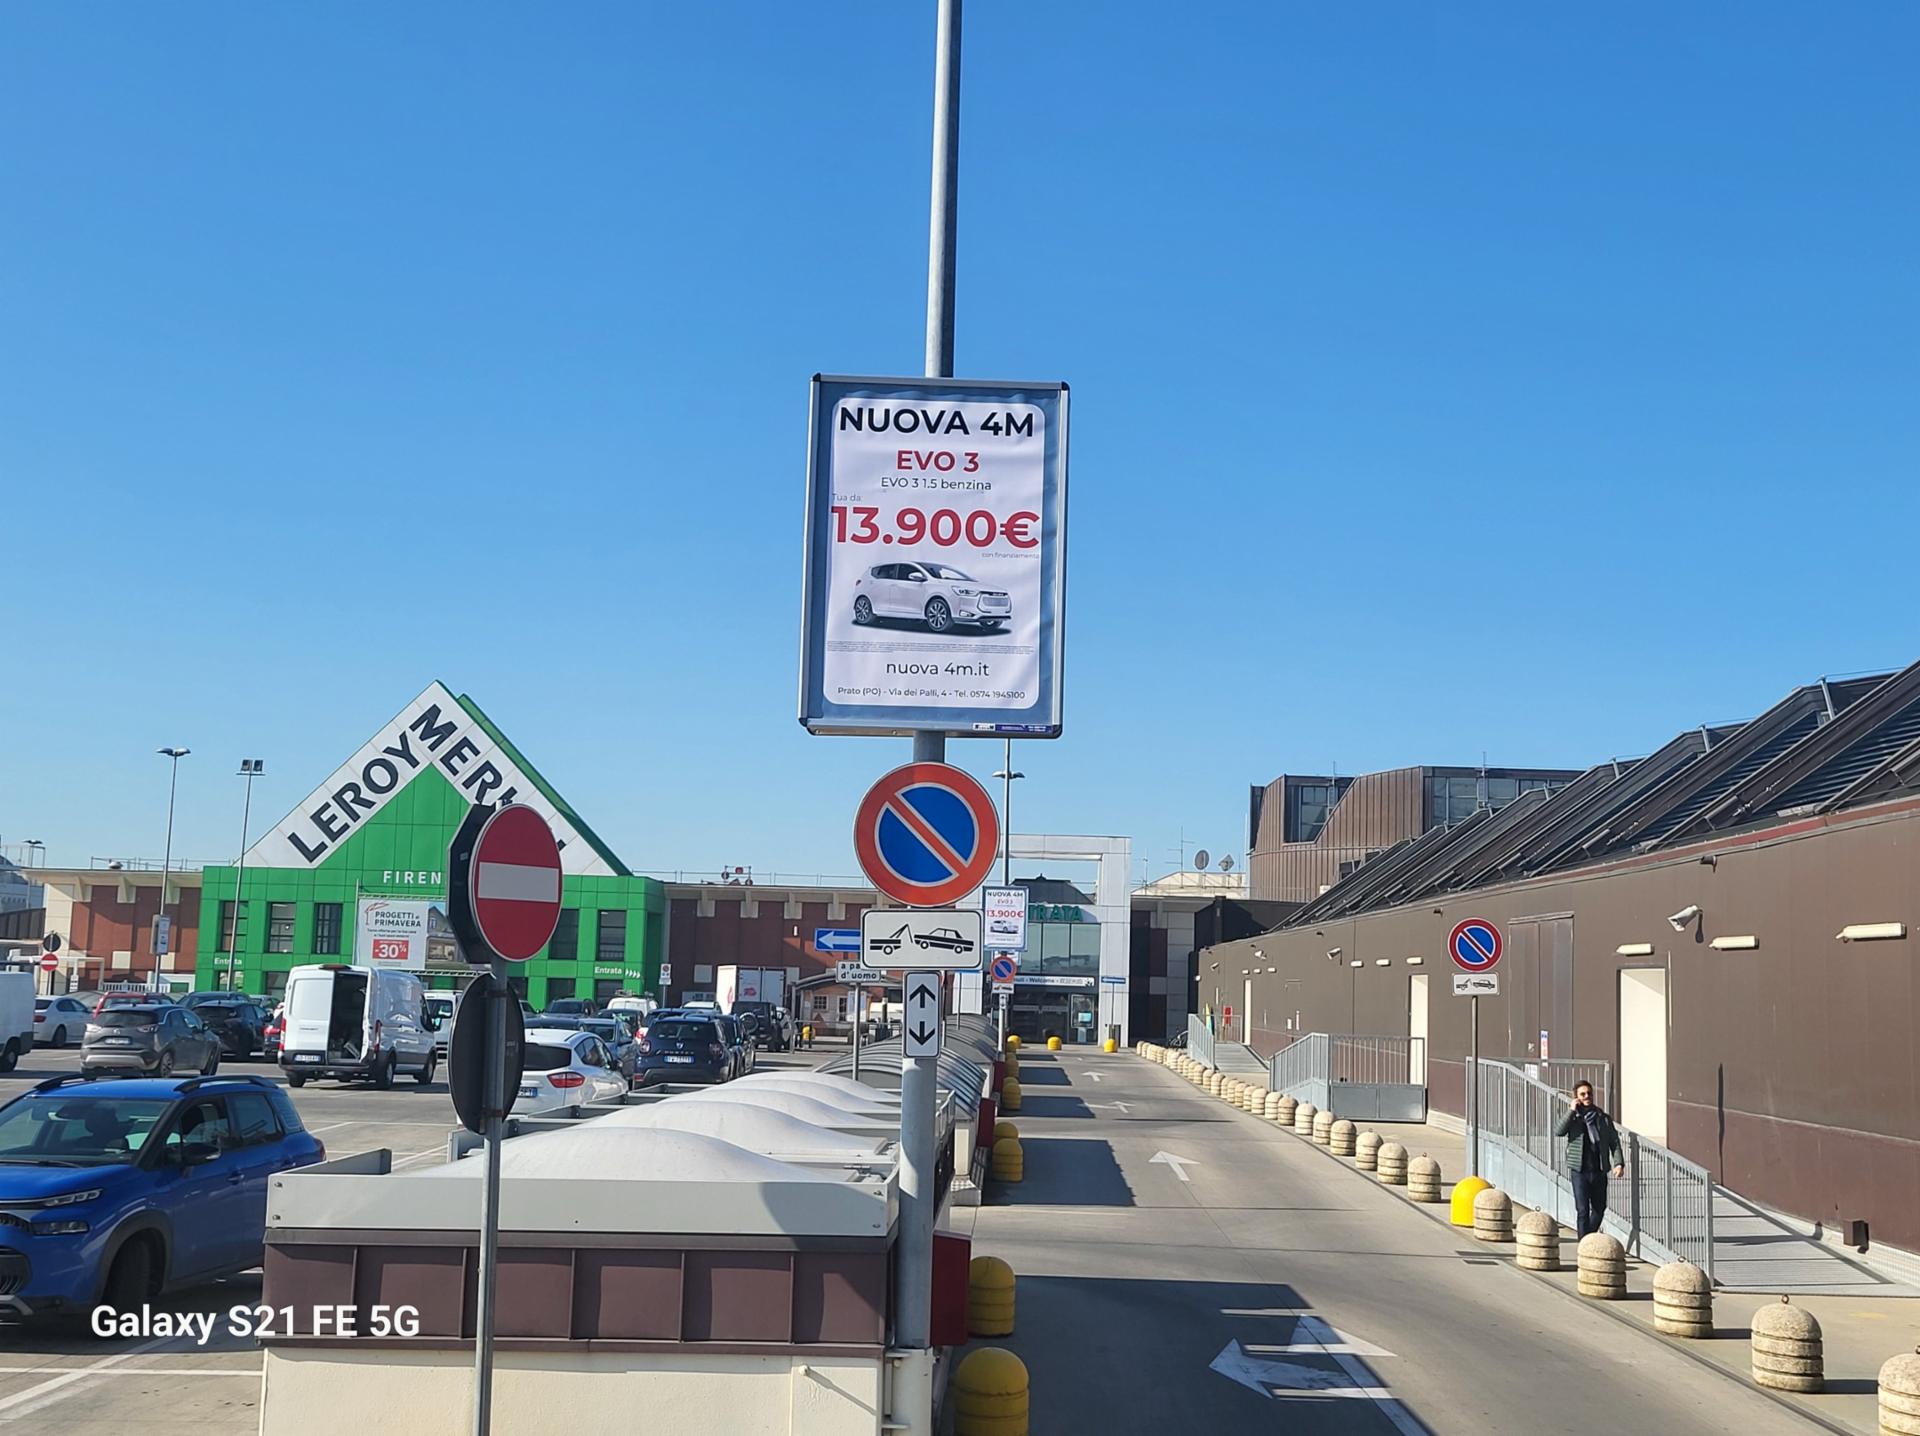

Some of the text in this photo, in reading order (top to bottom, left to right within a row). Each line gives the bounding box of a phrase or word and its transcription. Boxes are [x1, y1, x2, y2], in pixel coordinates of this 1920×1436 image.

[840, 407, 1034, 437] NUOVA 4M
[897, 450, 979, 472] EVO 3
[881, 477, 992, 491] EVO 3 1.5 benzina
[832, 493, 847, 501] Tua
[831, 506, 1041, 549] 13.900€
[886, 662, 989, 676] nuova 4m.it
[837, 687, 861, 695] Prato
[862, 687, 881, 696] (PO)
[888, 687, 902, 696] Via
[904, 688, 917, 696] dei
[919, 689, 939, 698] Palli,
[954, 690, 968, 698] Tel.
[970, 690, 990, 698] 0574
[993, 690, 1025, 699] 1945100
[287, 731, 420, 863] LEROY
[382, 870, 441, 885] FIREN
[375, 911, 414, 919] PROGETTI
[986, 910, 1024, 918] 13.900€
[1028, 904, 1083, 921] TRATA
[374, 919, 421, 927] PRIMAVERA
[374, 944, 407, 958] -30%
[214, 957, 242, 965] Entta
[594, 966, 622, 974] Entrata
